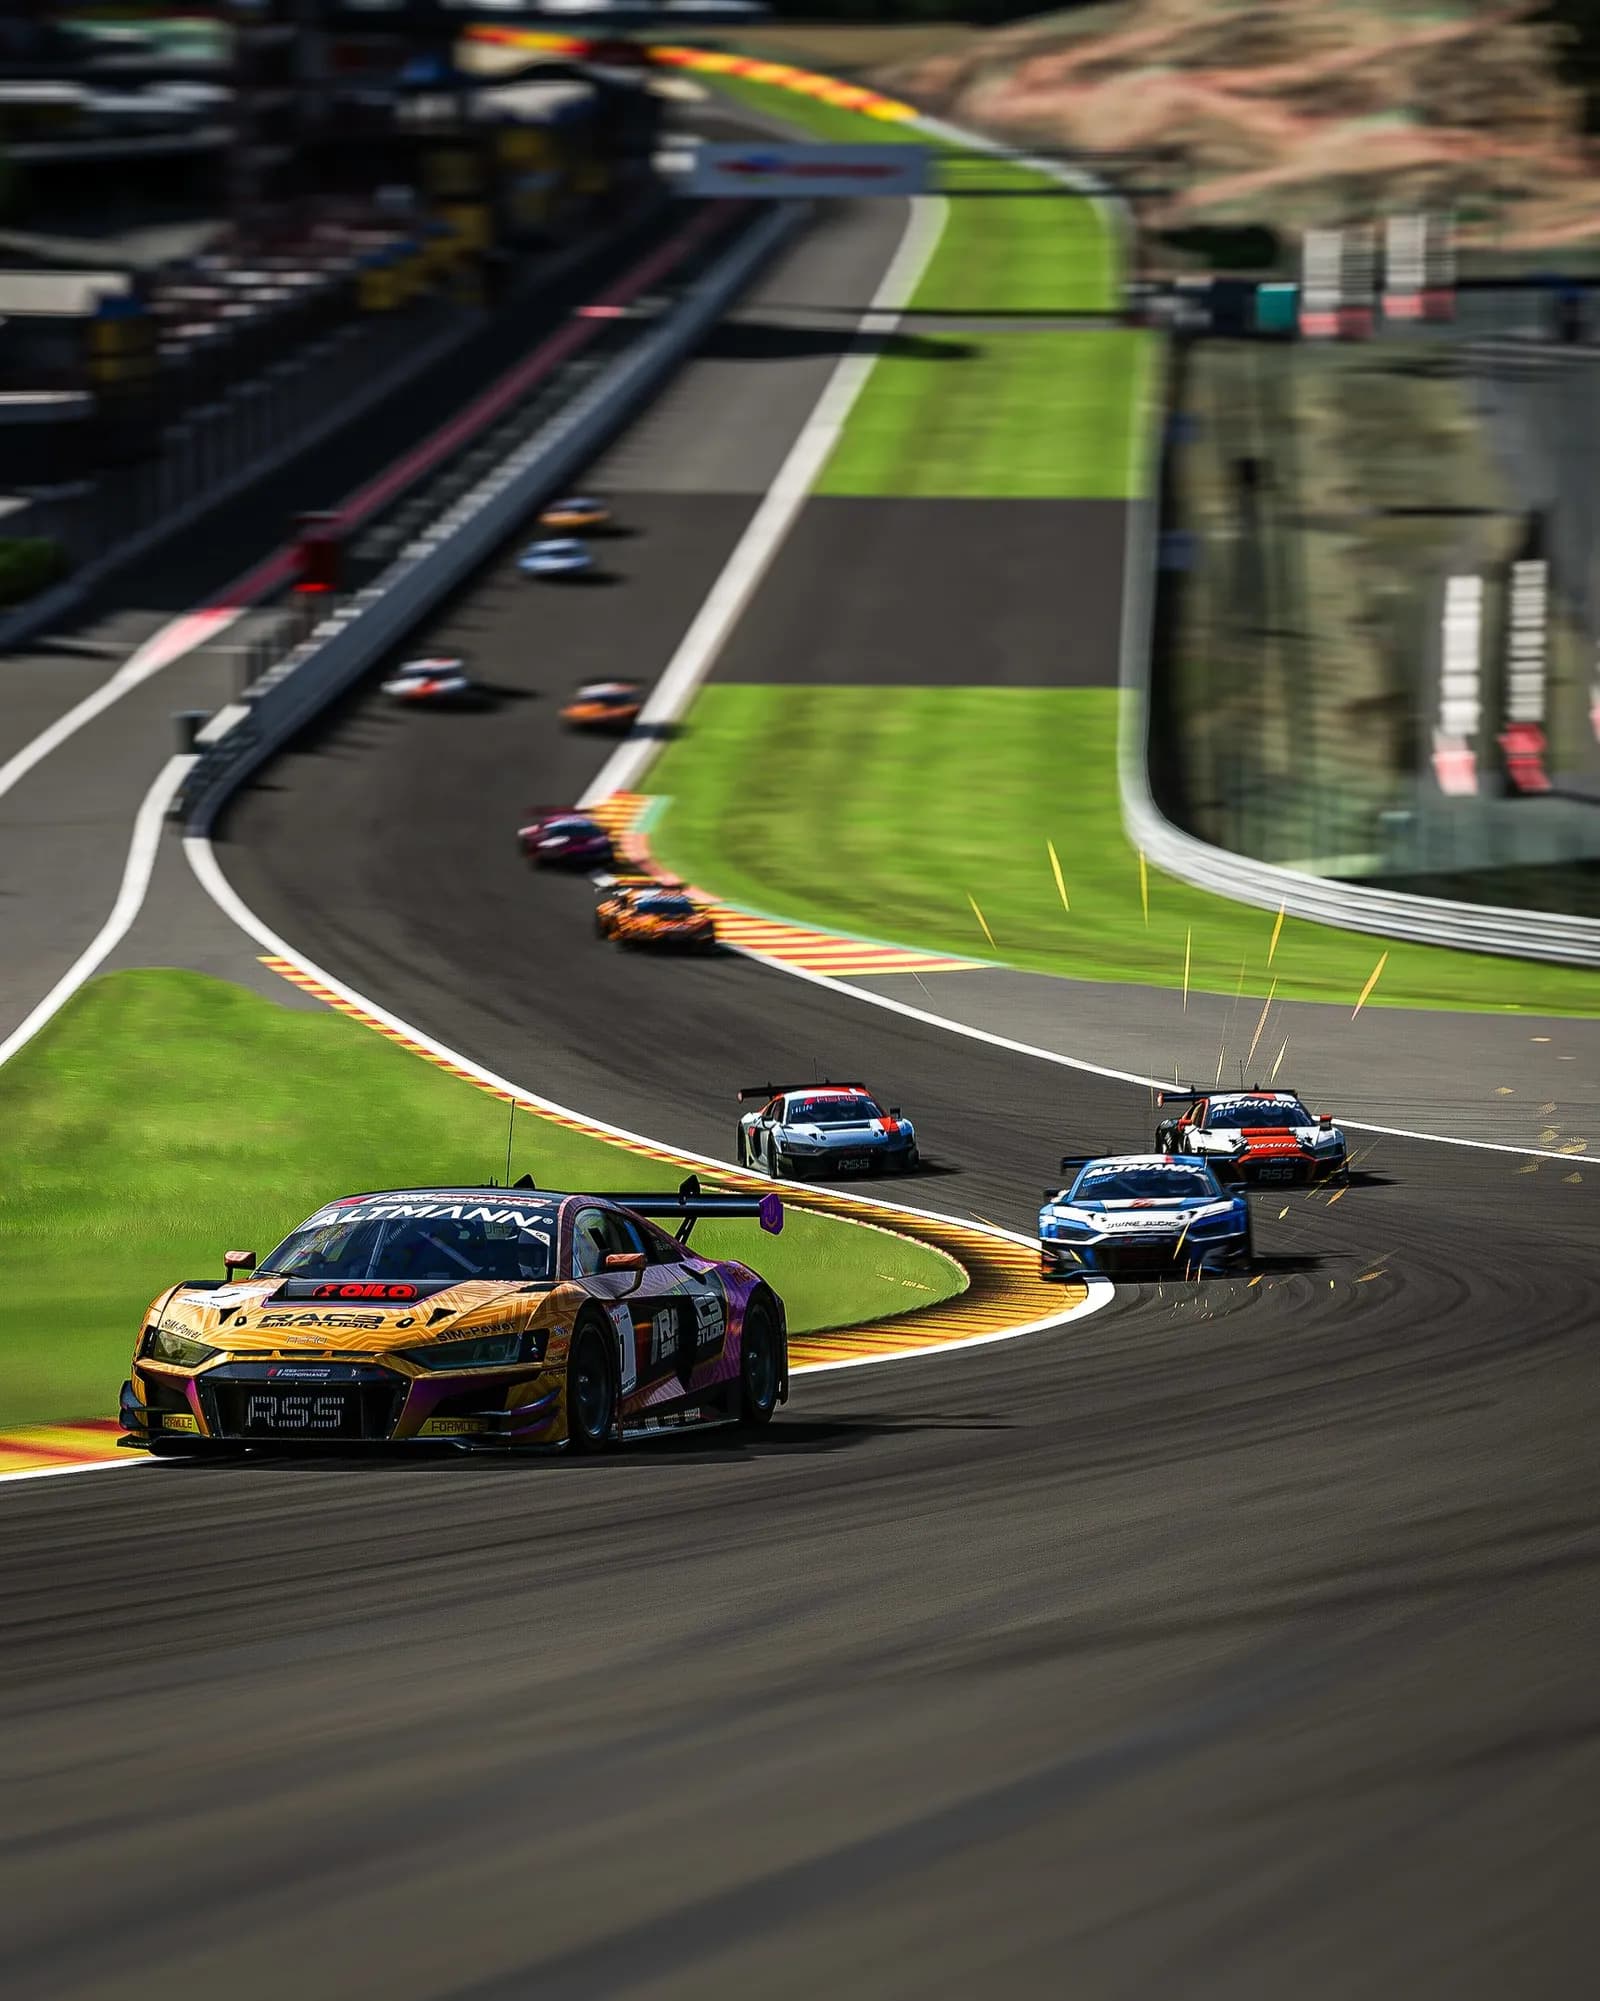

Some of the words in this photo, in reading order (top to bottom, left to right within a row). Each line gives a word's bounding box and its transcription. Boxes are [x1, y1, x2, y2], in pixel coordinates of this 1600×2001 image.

[1211, 1100, 1296, 1112] ALTMANN
[1086, 1164, 1200, 1178] ALTMANN
[301, 1205, 542, 1232] ALTMANN
[298, 1321, 380, 1329] STUDIO
[436, 1321, 517, 1341] SIM-Power
[245, 1396, 345, 1427] RSS
